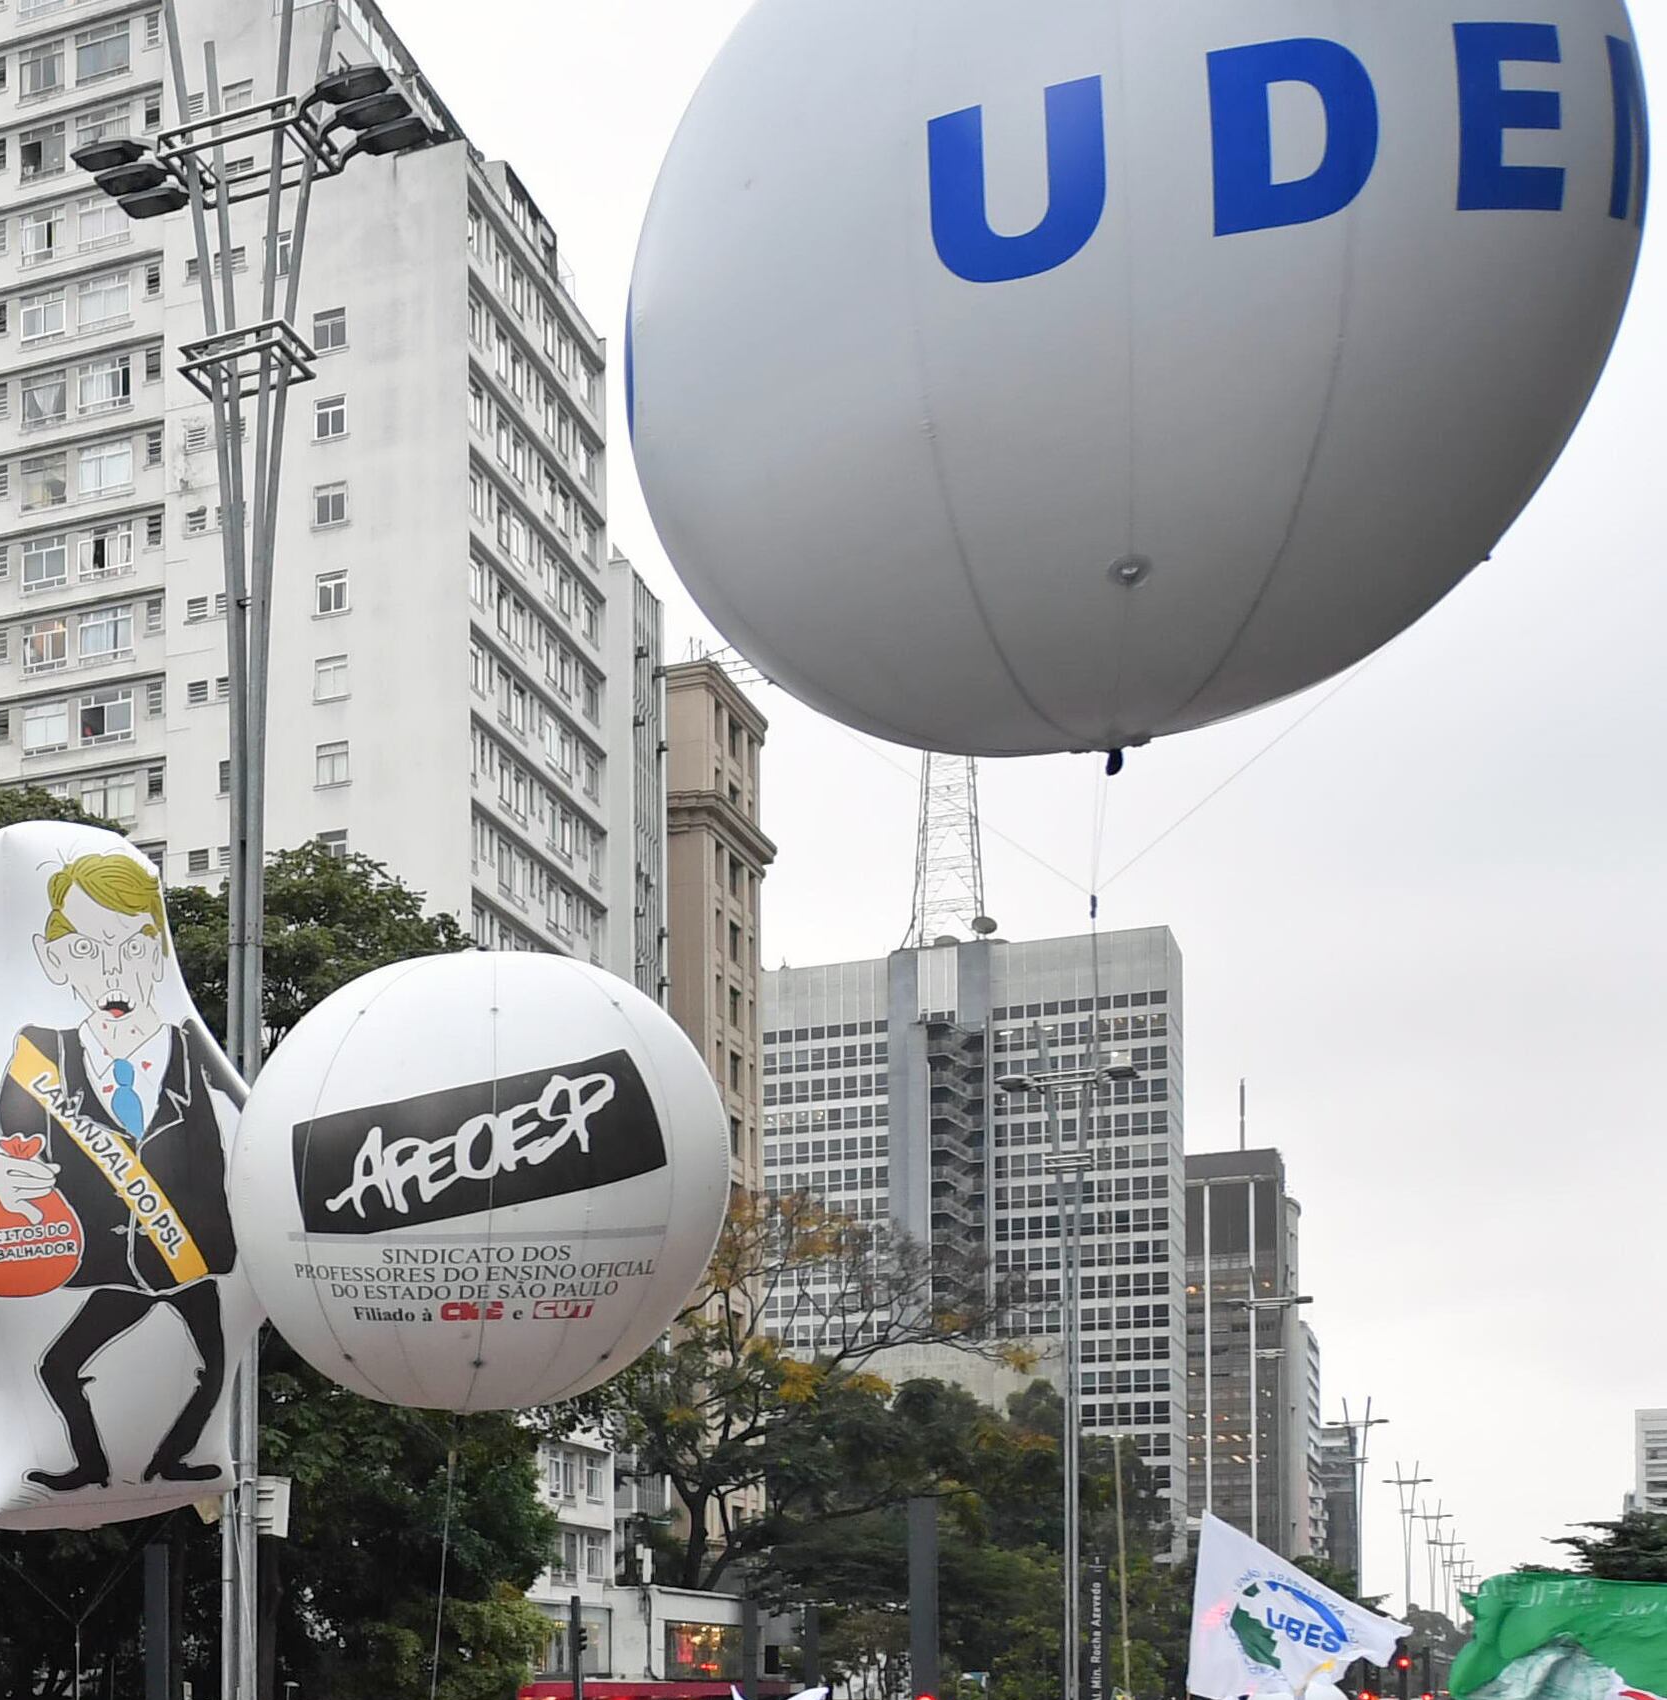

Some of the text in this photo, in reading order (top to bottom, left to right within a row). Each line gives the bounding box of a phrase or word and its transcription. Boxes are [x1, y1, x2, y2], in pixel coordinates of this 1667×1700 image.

[324, 1072, 616, 1220] APEOESP
[126, 1178, 158, 1214] DO
[48, 1223, 70, 1237] DO
[152, 1212, 185, 1257] PSL
[294, 1259, 658, 1283] PROFESSORES DO ENSINO OFICIAL
[381, 1244, 573, 1266] SINDICATO DOS
[331, 1279, 619, 1301] DO ESTADO DE SÃO PAULO
[353, 1305, 416, 1323] Filiado
[512, 1309, 525, 1321] e
[533, 1300, 596, 1321] CUT
[1089, 1581, 1103, 1628] Azevedo
[1090, 1630, 1103, 1664] Rocha
[1266, 1606, 1342, 1654] UBES
